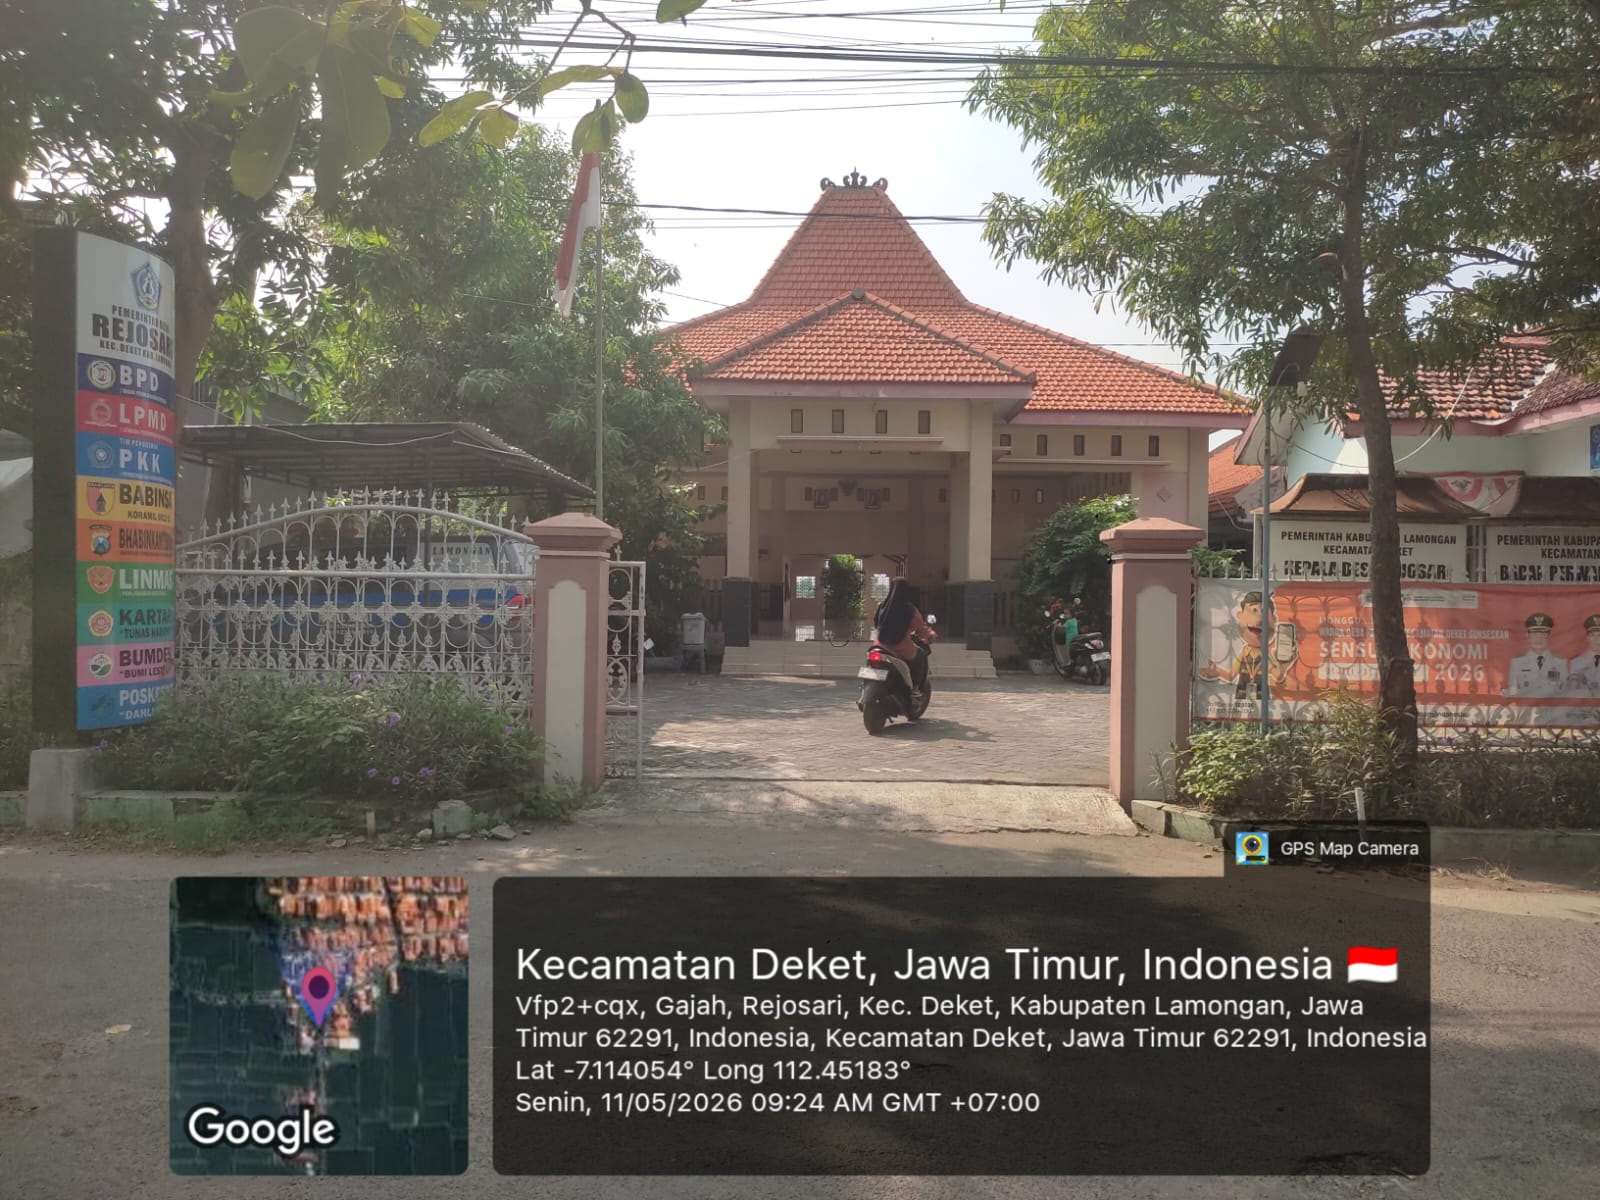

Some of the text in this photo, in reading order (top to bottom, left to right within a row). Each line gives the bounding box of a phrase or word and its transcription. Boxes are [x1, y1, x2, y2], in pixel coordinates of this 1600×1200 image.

[120, 364, 159, 392] BPD
[119, 403, 167, 432] LPMD
[119, 448, 160, 473] PKK
[1281, 531, 1343, 541] PEMERINTAH
[1404, 534, 1457, 545] LAMONGAN
[1497, 534, 1560, 546] PEMERINTAH
[1323, 545, 1373, 555] KECAMATA
[1283, 560, 1337, 577] KEPALA
[1341, 561, 1370, 578] DES
[1319, 641, 1488, 660] SENSU KONOMI
[1434, 663, 1484, 682] 2026
